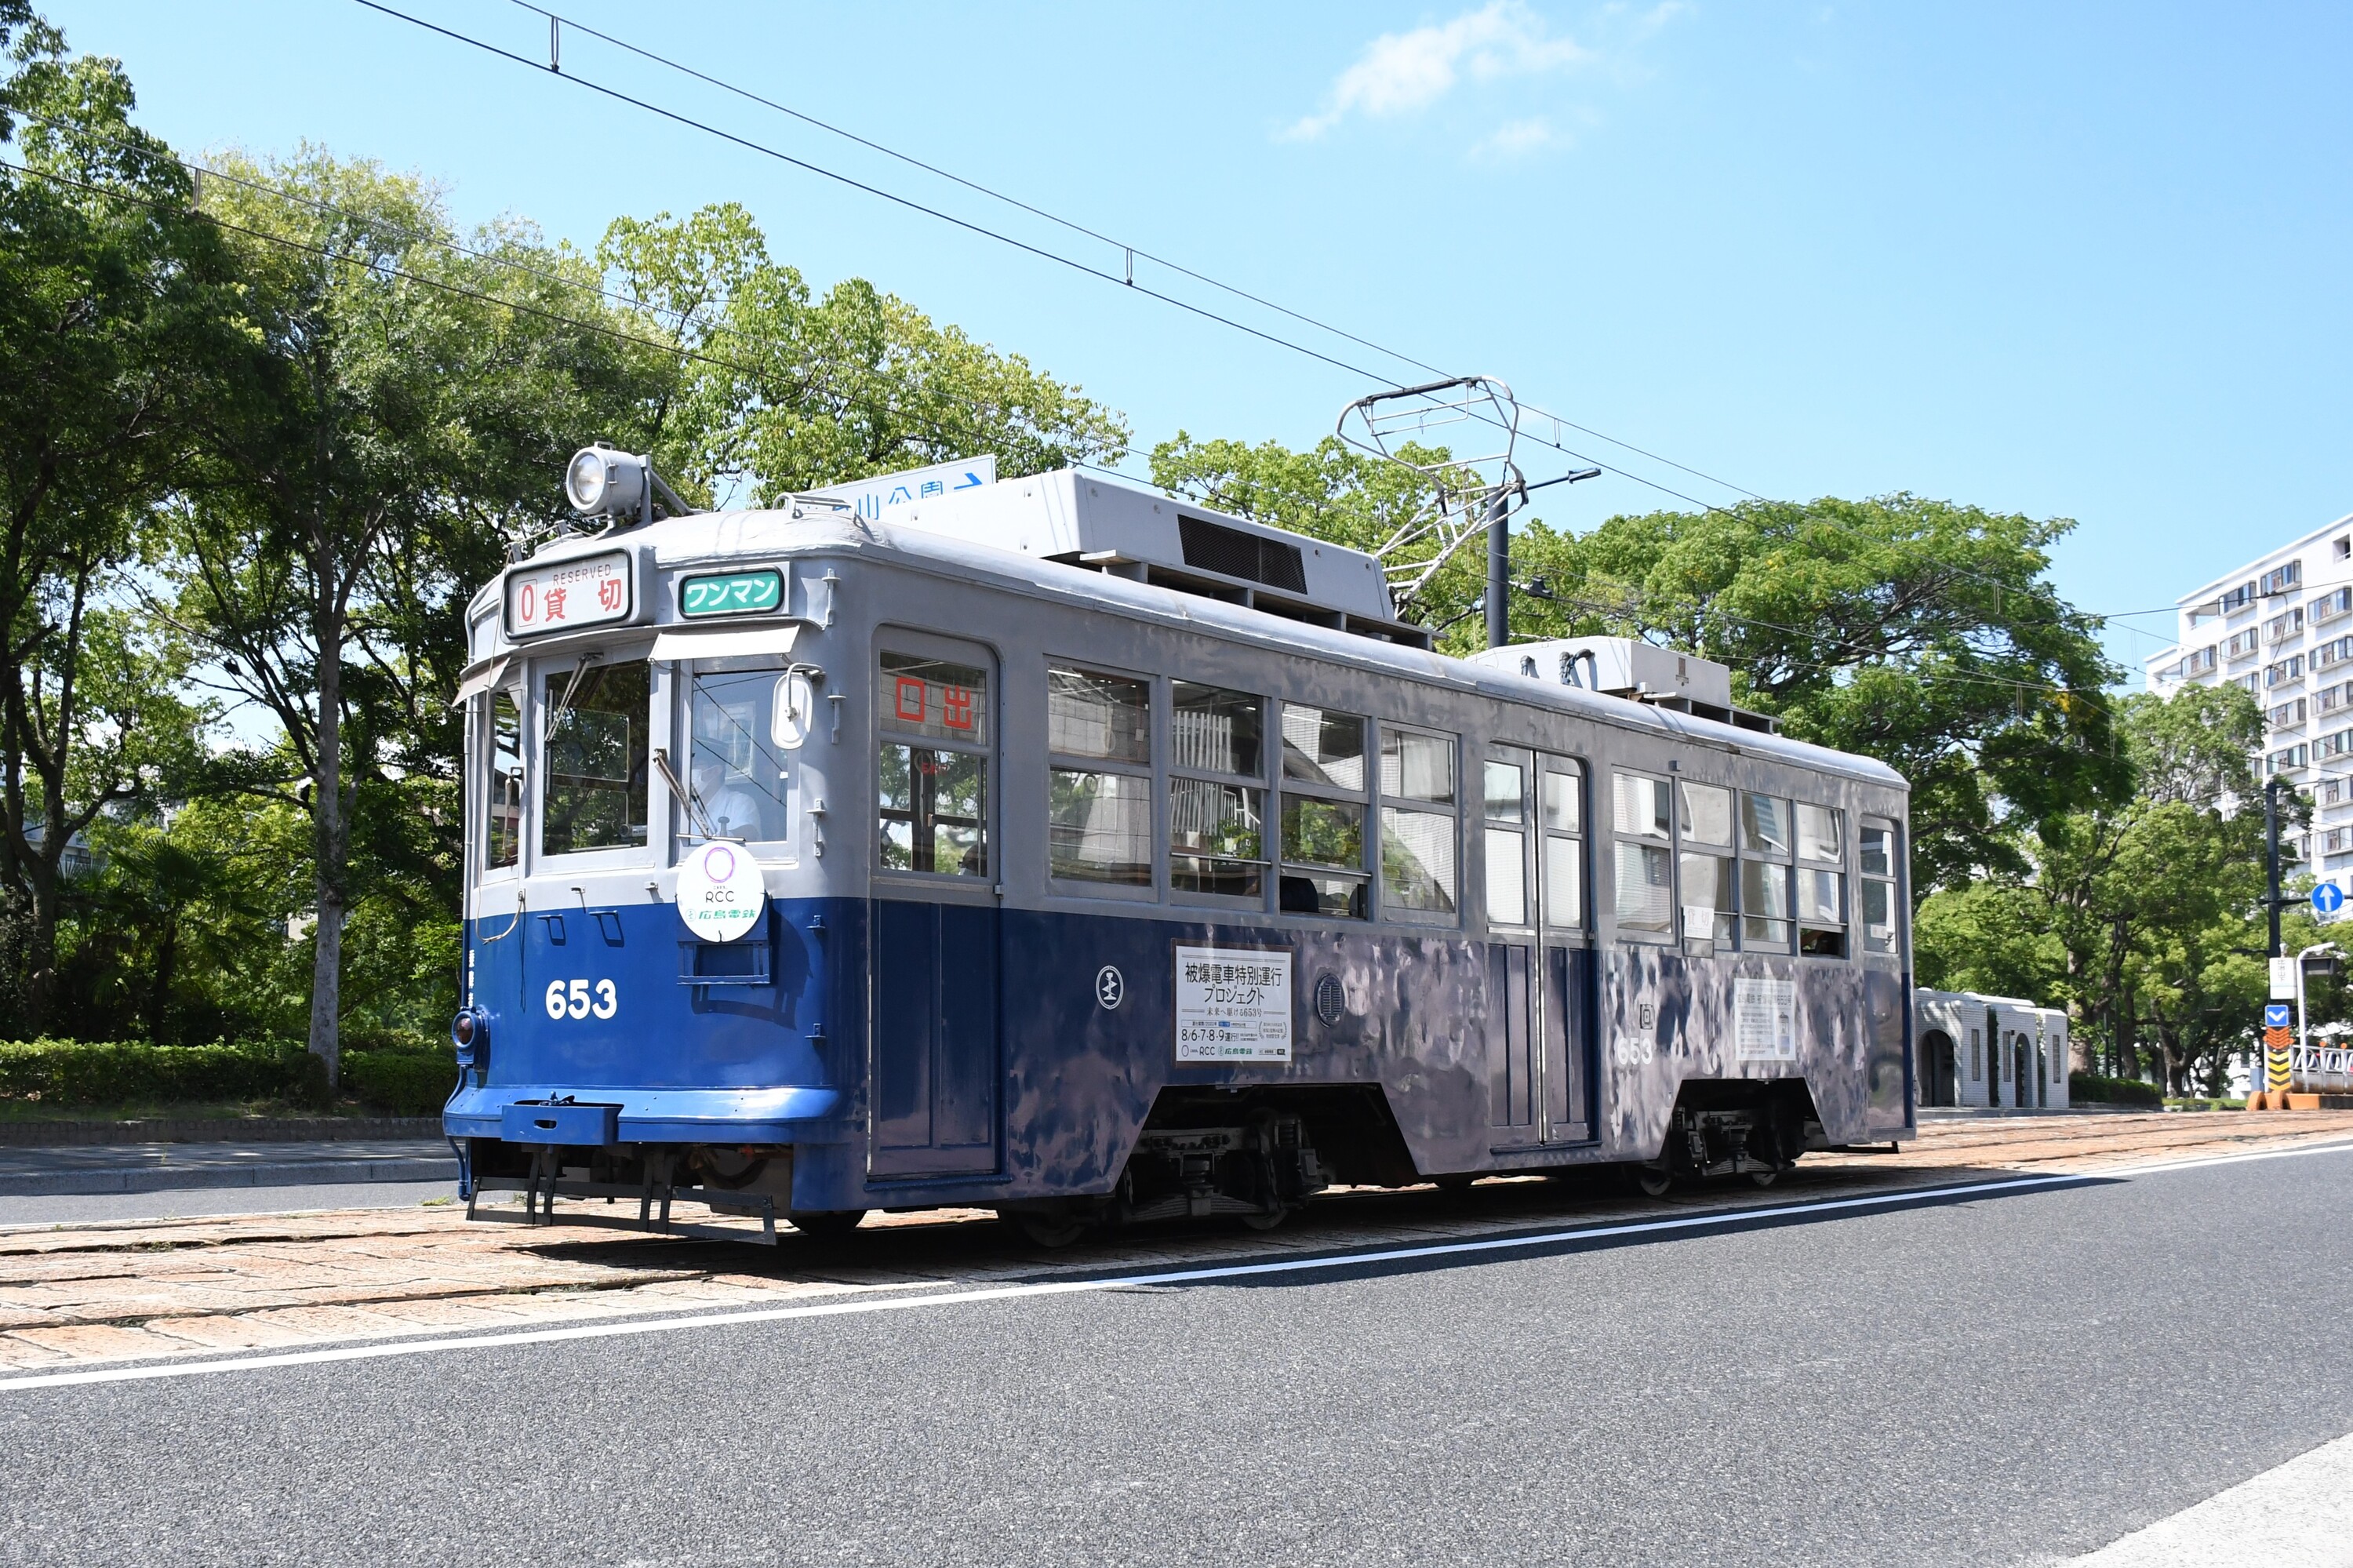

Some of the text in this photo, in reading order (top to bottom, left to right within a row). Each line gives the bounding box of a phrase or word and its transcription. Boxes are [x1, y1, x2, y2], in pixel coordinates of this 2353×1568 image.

[832, 481, 943, 520] 山公園
[553, 564, 612, 586] RESERVED
[544, 578, 622, 622] 貸切
[686, 579, 775, 608] ワンマン
[705, 890, 735, 903] RCC
[1184, 962, 1282, 987] 被爆電車特別運行
[545, 978, 617, 1020] 653
[1204, 983, 1265, 1006] プロジェクト
[1206, 1006, 1263, 1017] 未来へ駆ける653号
[1199, 1046, 1215, 1056] RCC
[1617, 1037, 1653, 1065] 653
